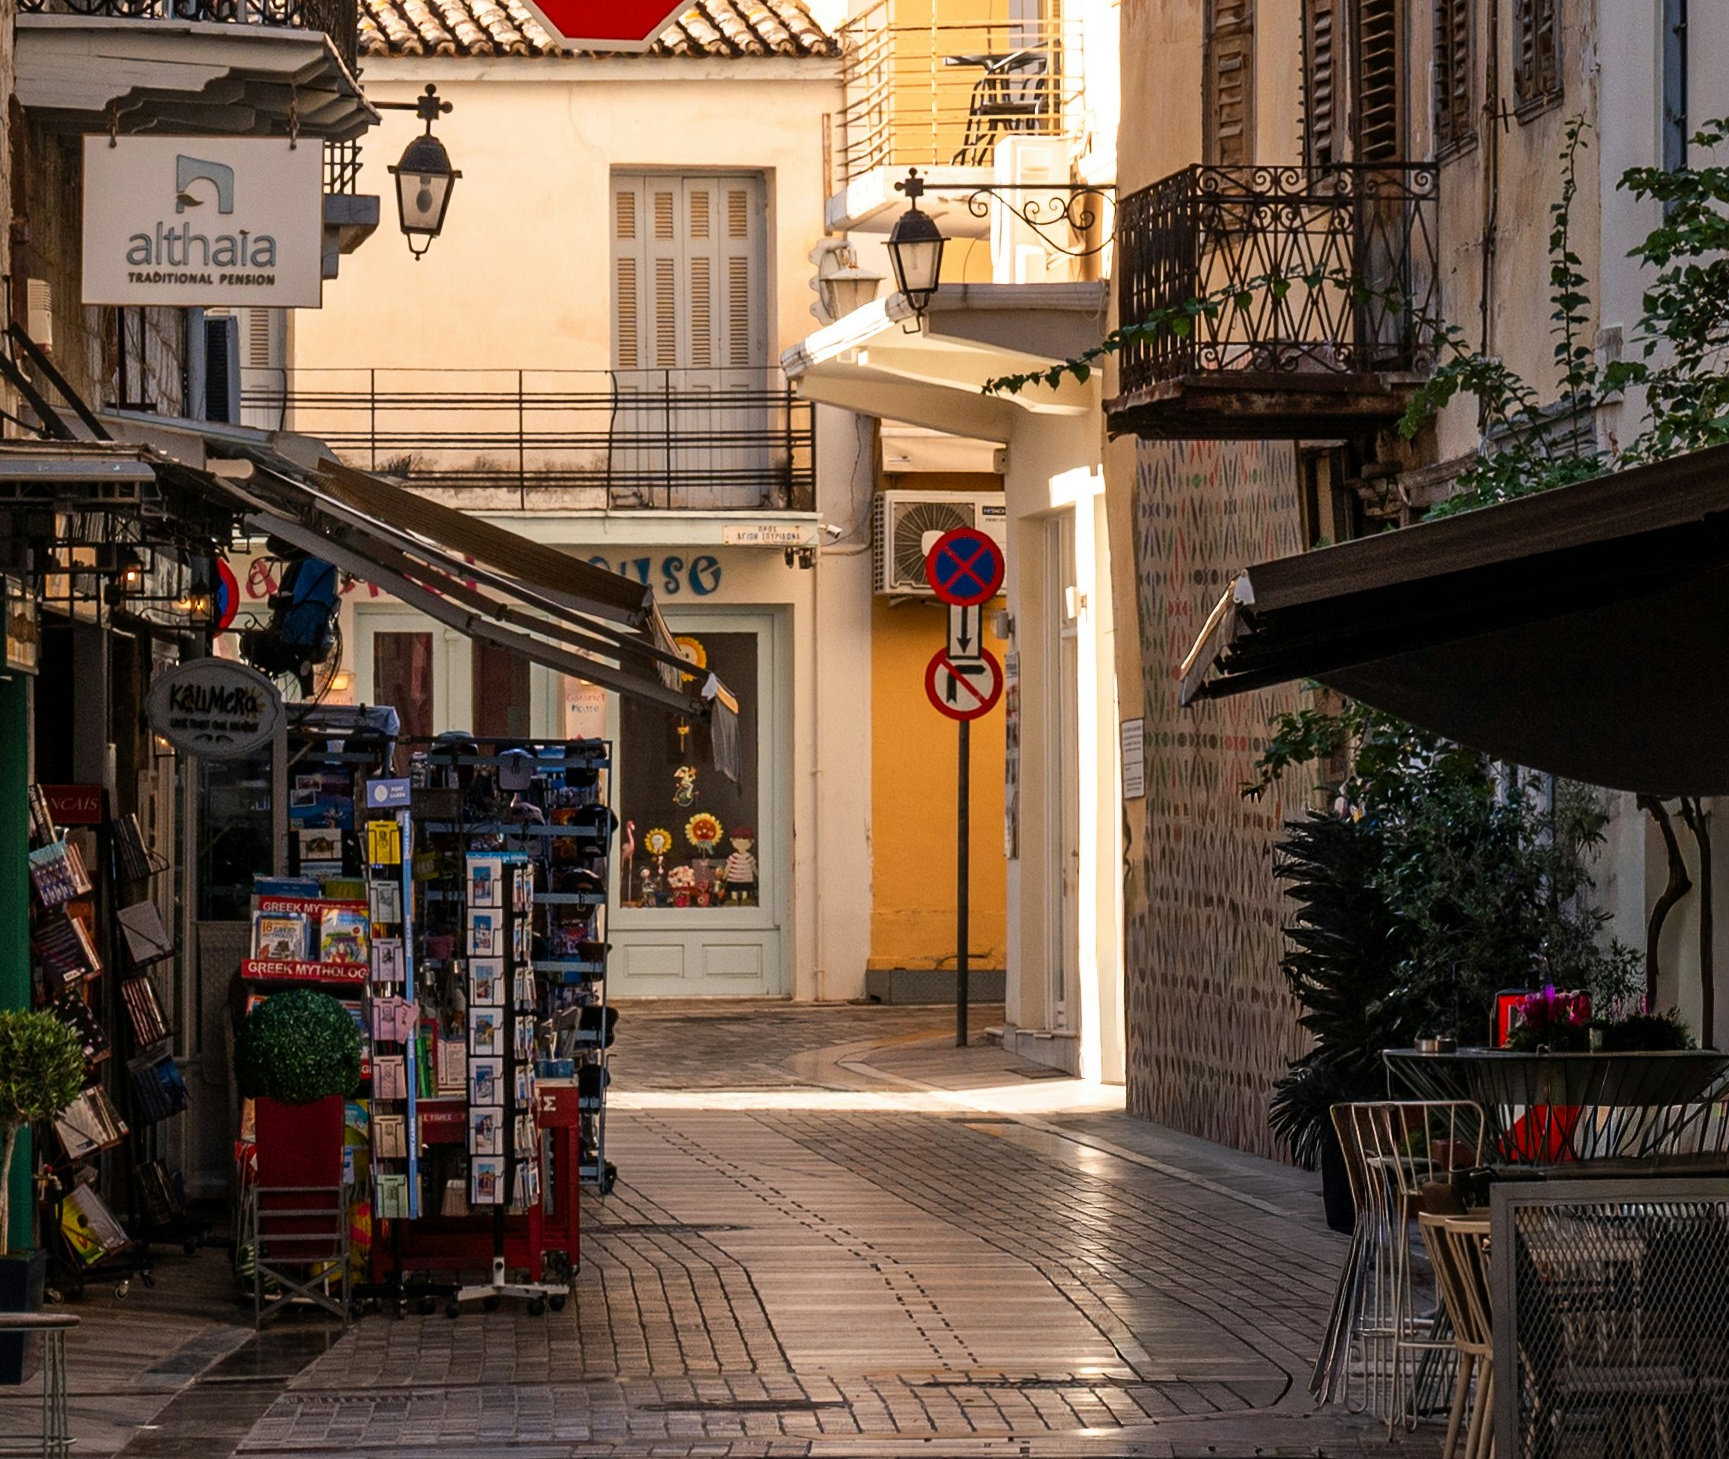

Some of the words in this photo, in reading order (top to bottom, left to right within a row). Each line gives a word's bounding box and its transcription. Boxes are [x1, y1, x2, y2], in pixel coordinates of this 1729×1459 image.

[126, 220, 277, 268] althaia
[128, 272, 213, 285] TRADITIONAL
[219, 274, 275, 286] PENSION
[262, 901, 302, 912] GREEK
[247, 961, 292, 975] GREEK
